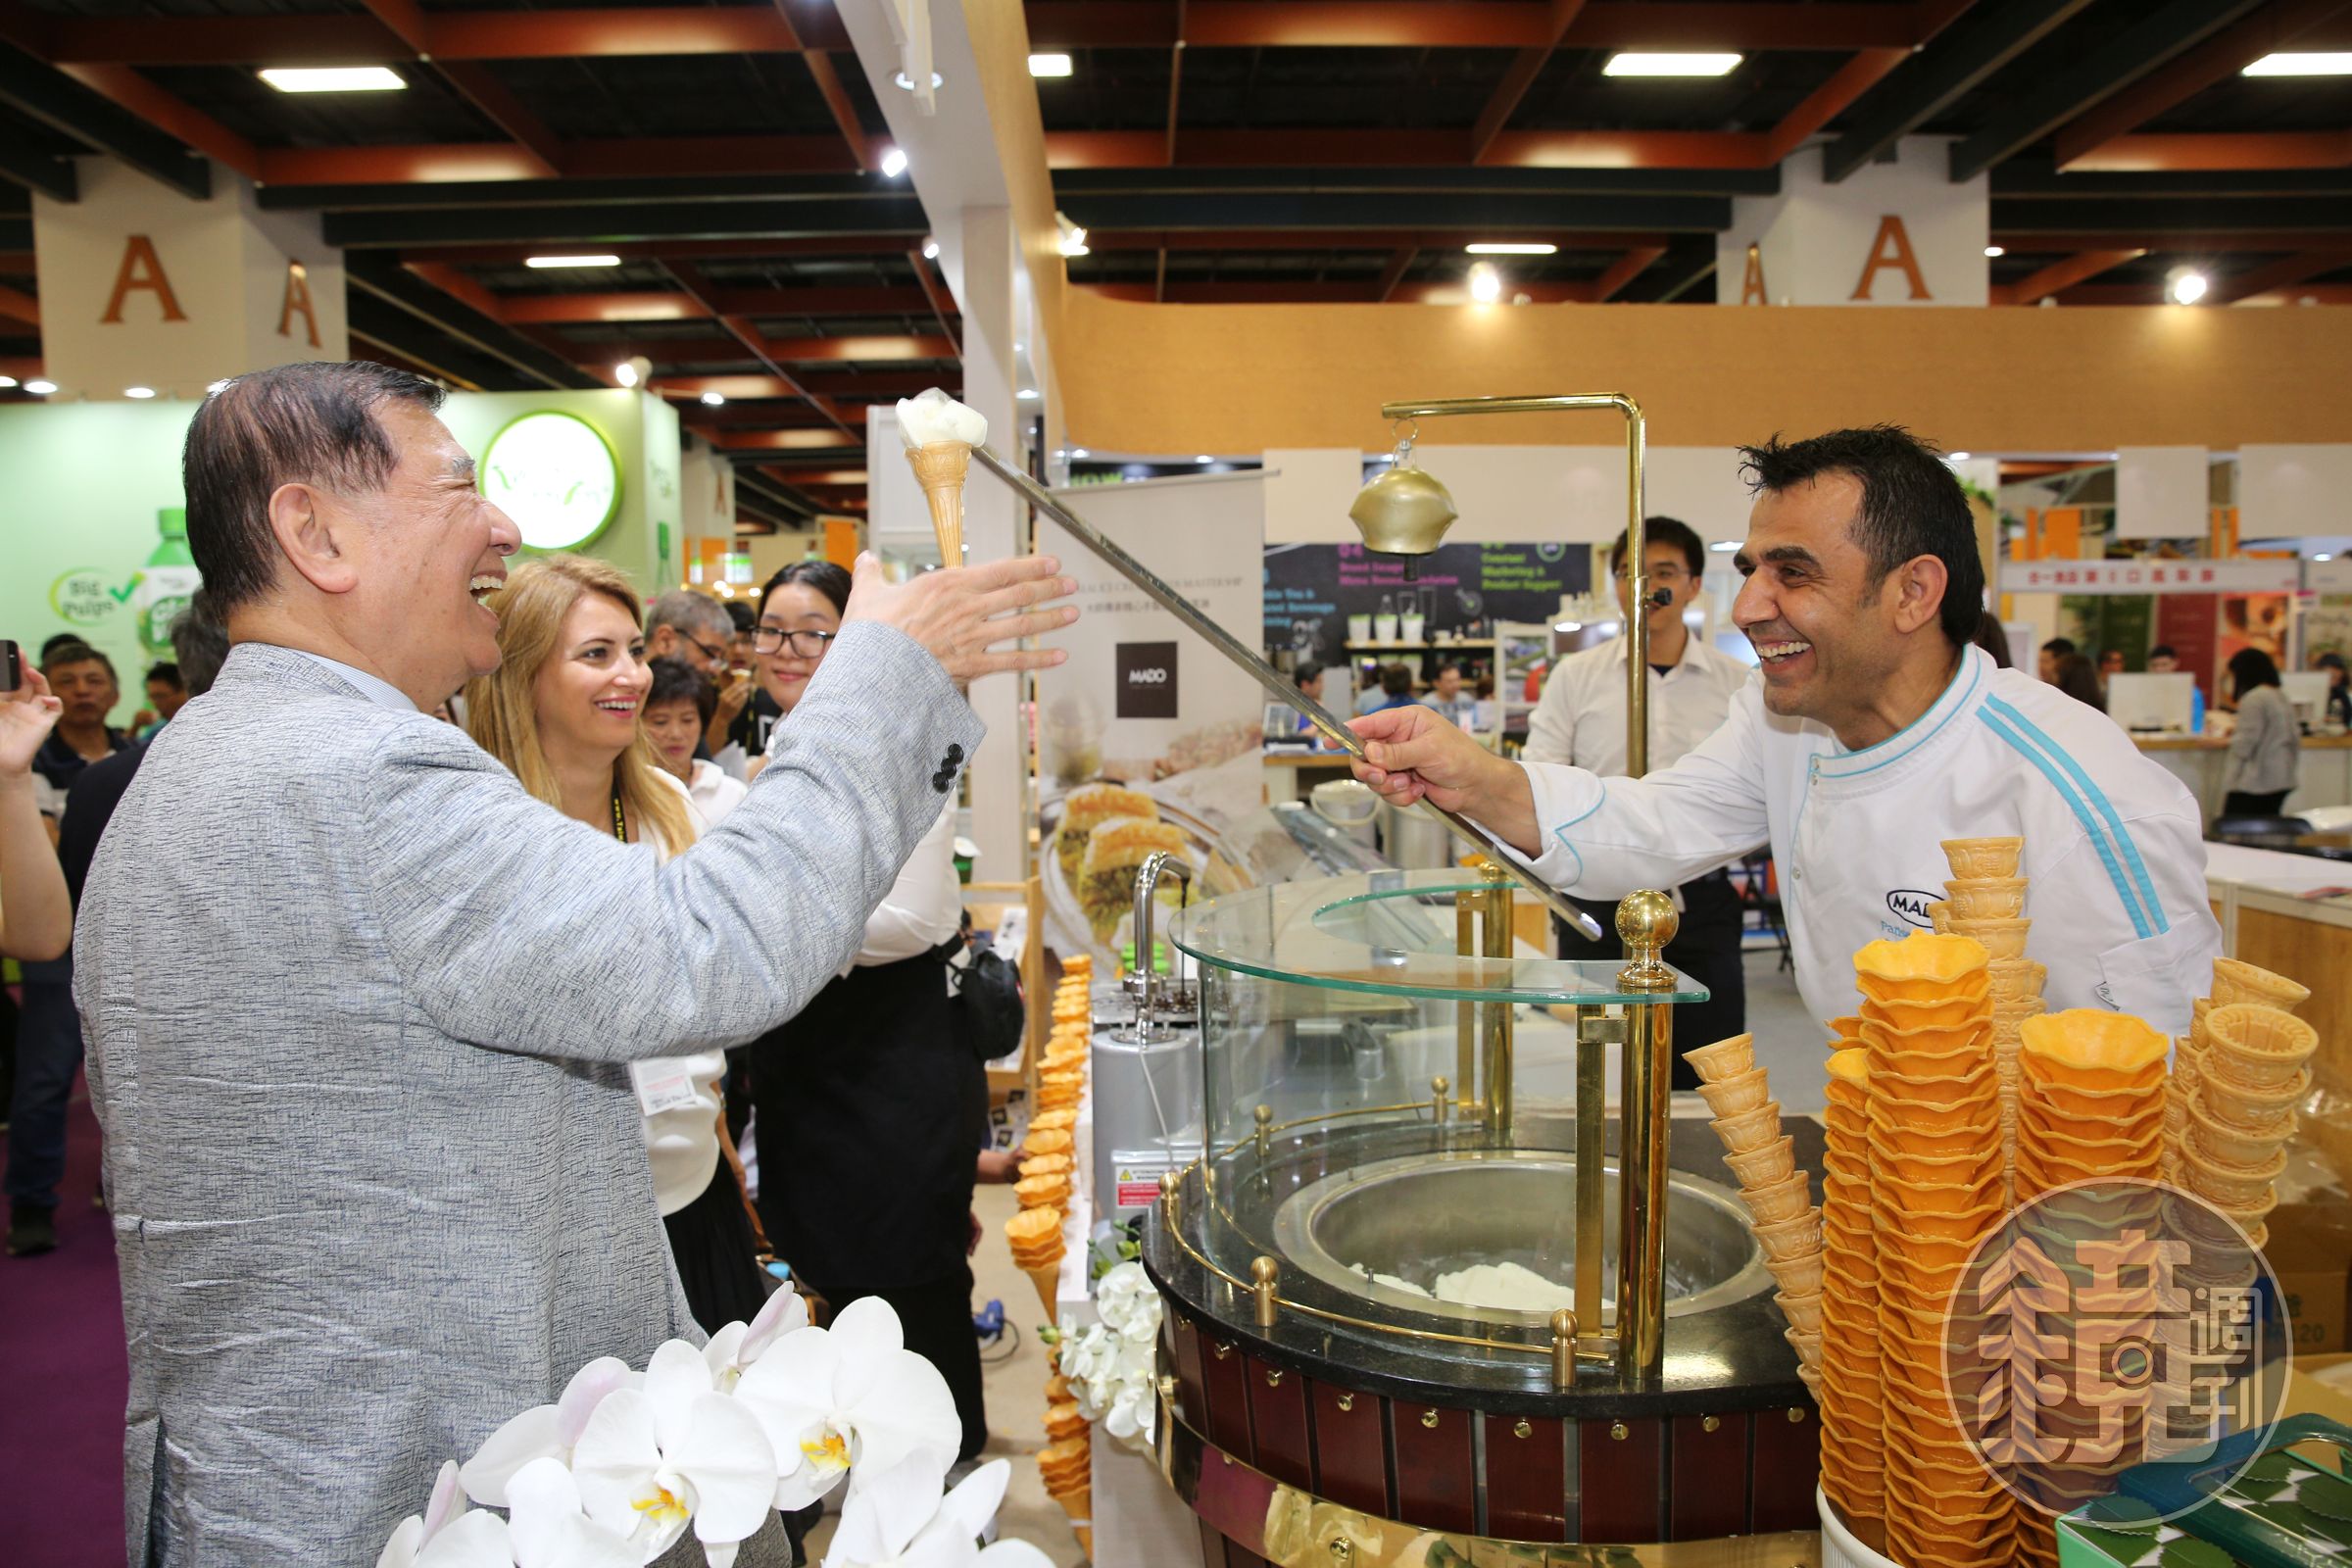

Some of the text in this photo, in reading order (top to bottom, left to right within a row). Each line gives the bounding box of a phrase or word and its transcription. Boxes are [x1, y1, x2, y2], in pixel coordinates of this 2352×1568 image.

[101, 235, 188, 323] A
[1742, 242, 1767, 305] A
[1848, 214, 1933, 301] A
[278, 259, 321, 348] A
[1129, 668, 1167, 683] MADO
